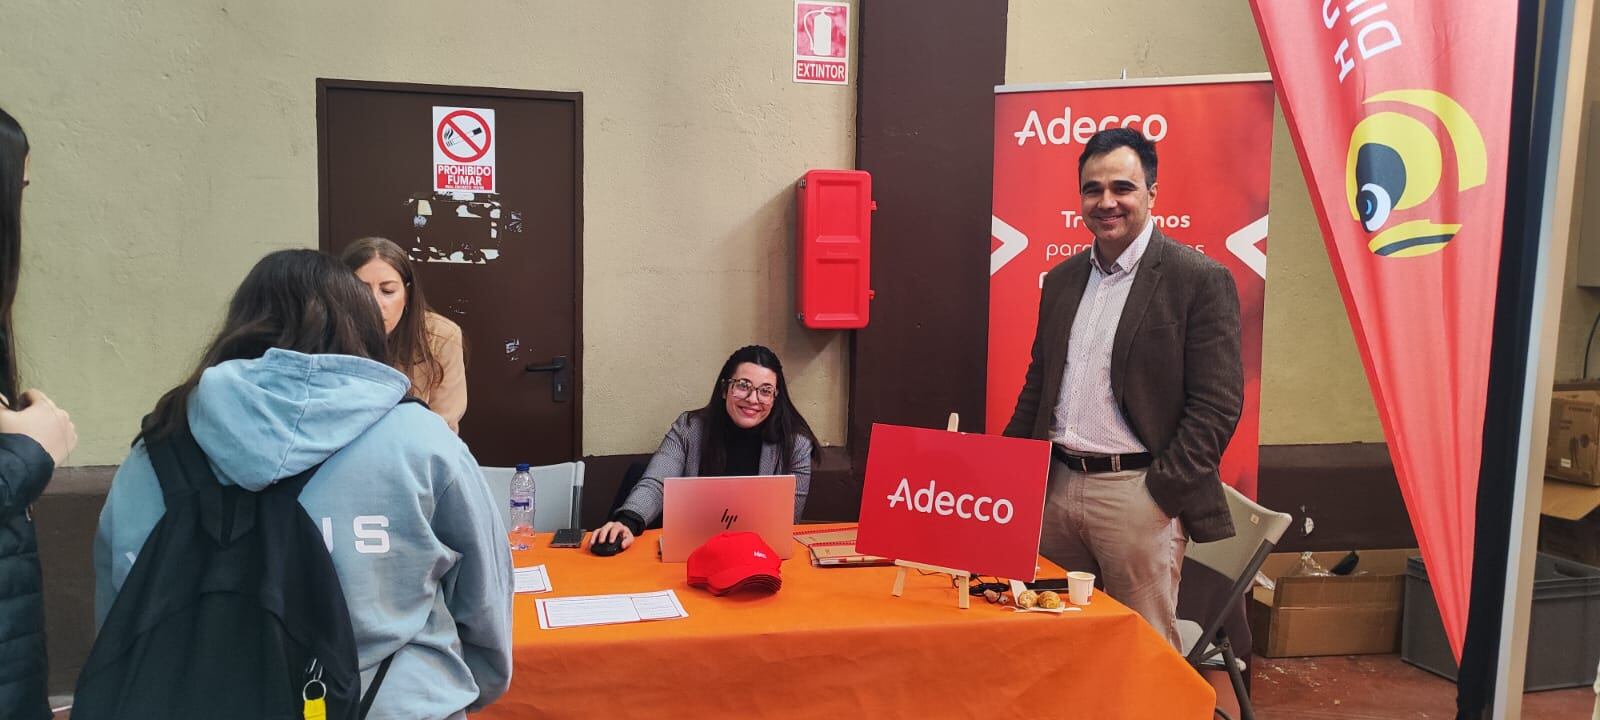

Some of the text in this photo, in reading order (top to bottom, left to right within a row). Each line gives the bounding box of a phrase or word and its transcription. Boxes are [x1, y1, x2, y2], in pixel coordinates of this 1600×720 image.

[797, 62, 845, 79] EXTINTOR
[438, 165, 491, 176] PROHIBIDO
[447, 175, 482, 185] FUMAR
[886, 478, 1014, 525] Adecco
